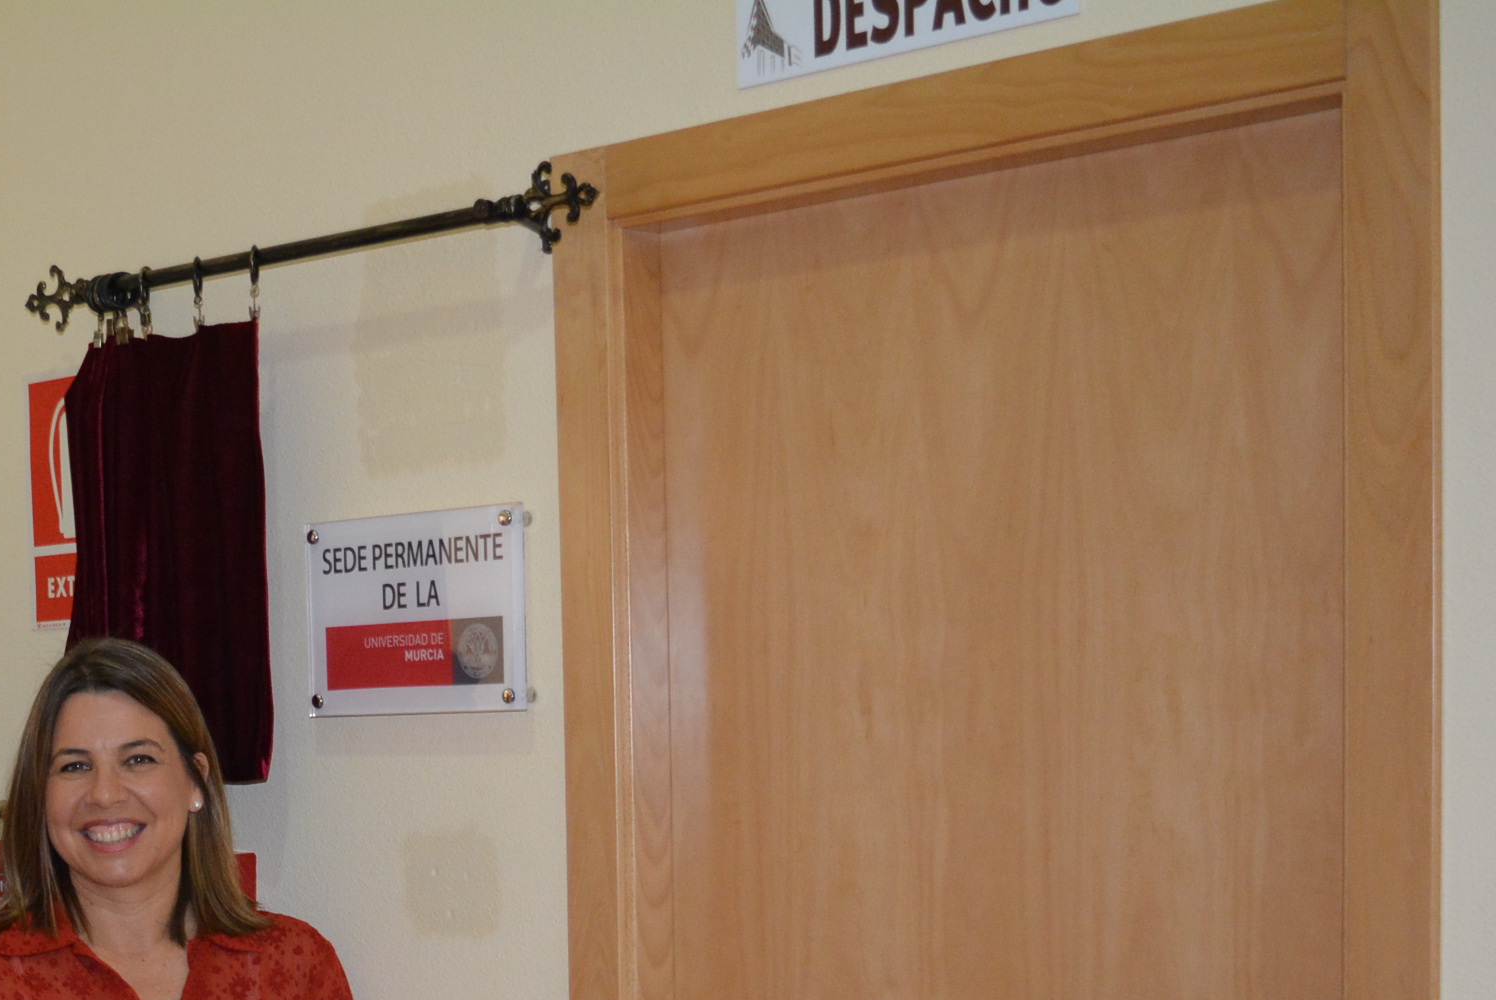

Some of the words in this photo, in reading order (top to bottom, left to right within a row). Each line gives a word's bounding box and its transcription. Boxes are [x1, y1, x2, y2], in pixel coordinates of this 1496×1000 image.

[322, 545, 368, 575] SEDE
[372, 532, 503, 571] PERMANENTE
[382, 582, 407, 610] DE
[416, 579, 440, 607] LA
[364, 633, 429, 649] UNIVERSIDAD
[431, 632, 444, 645] DE
[405, 649, 444, 662] MURCIA
